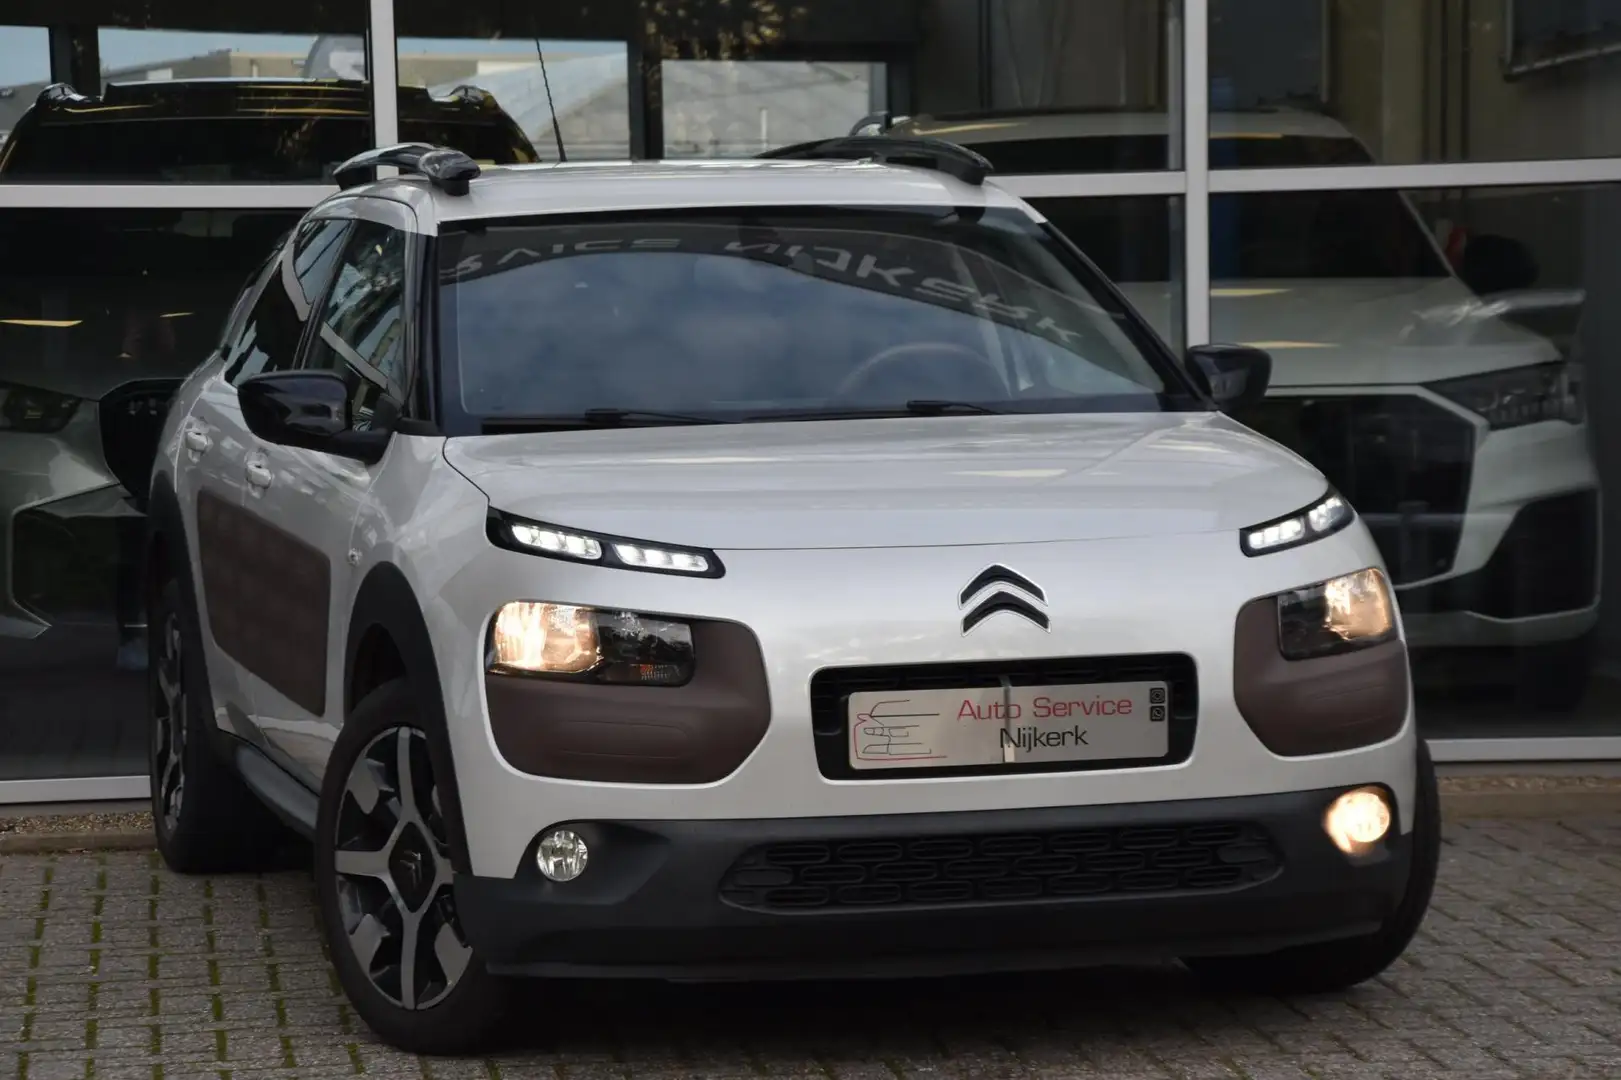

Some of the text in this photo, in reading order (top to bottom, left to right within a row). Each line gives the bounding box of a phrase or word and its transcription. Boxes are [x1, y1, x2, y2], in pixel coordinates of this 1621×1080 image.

[957, 694, 1133, 721] Auto Service
[999, 725, 1089, 753] Nijkerk
